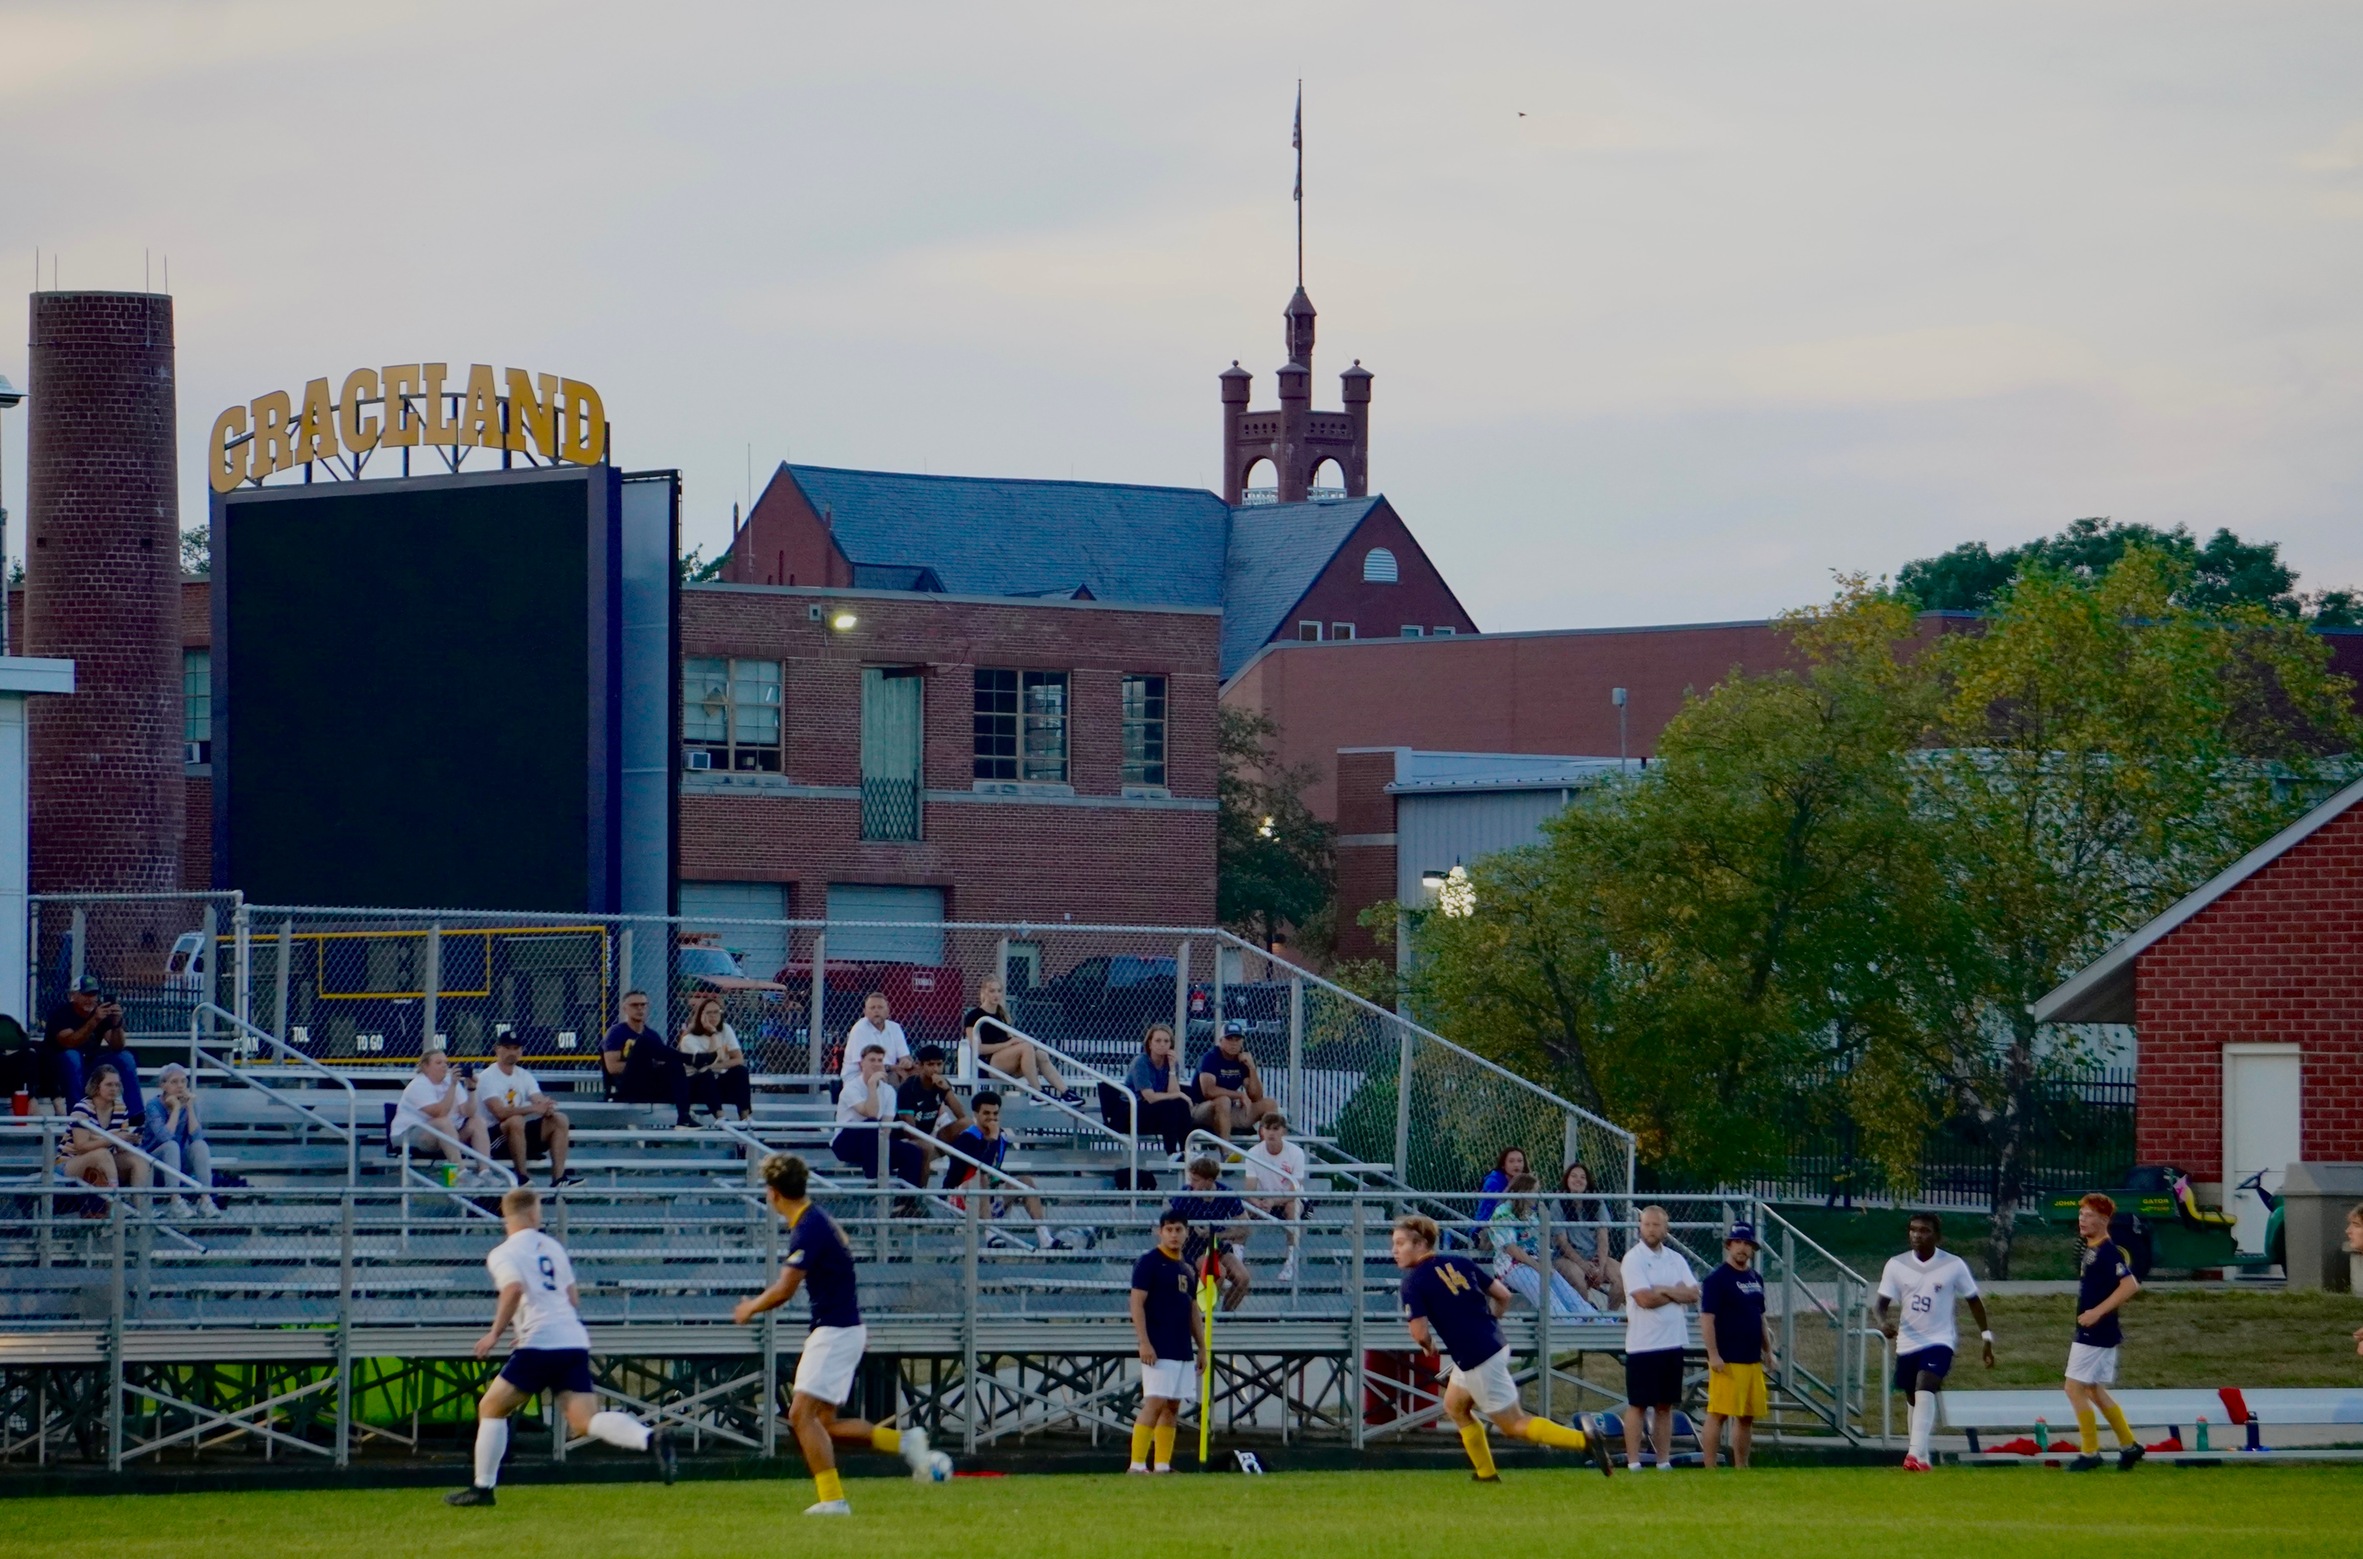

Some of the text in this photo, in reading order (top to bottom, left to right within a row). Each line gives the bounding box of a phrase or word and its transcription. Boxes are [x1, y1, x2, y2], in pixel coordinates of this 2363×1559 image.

[208, 362, 606, 494] GRACELAND
[356, 1034, 384, 1050] TO GO
[539, 1256, 557, 1291] 9
[1434, 1262, 1471, 1296] 14
[1911, 1294, 1931, 1312] 29
